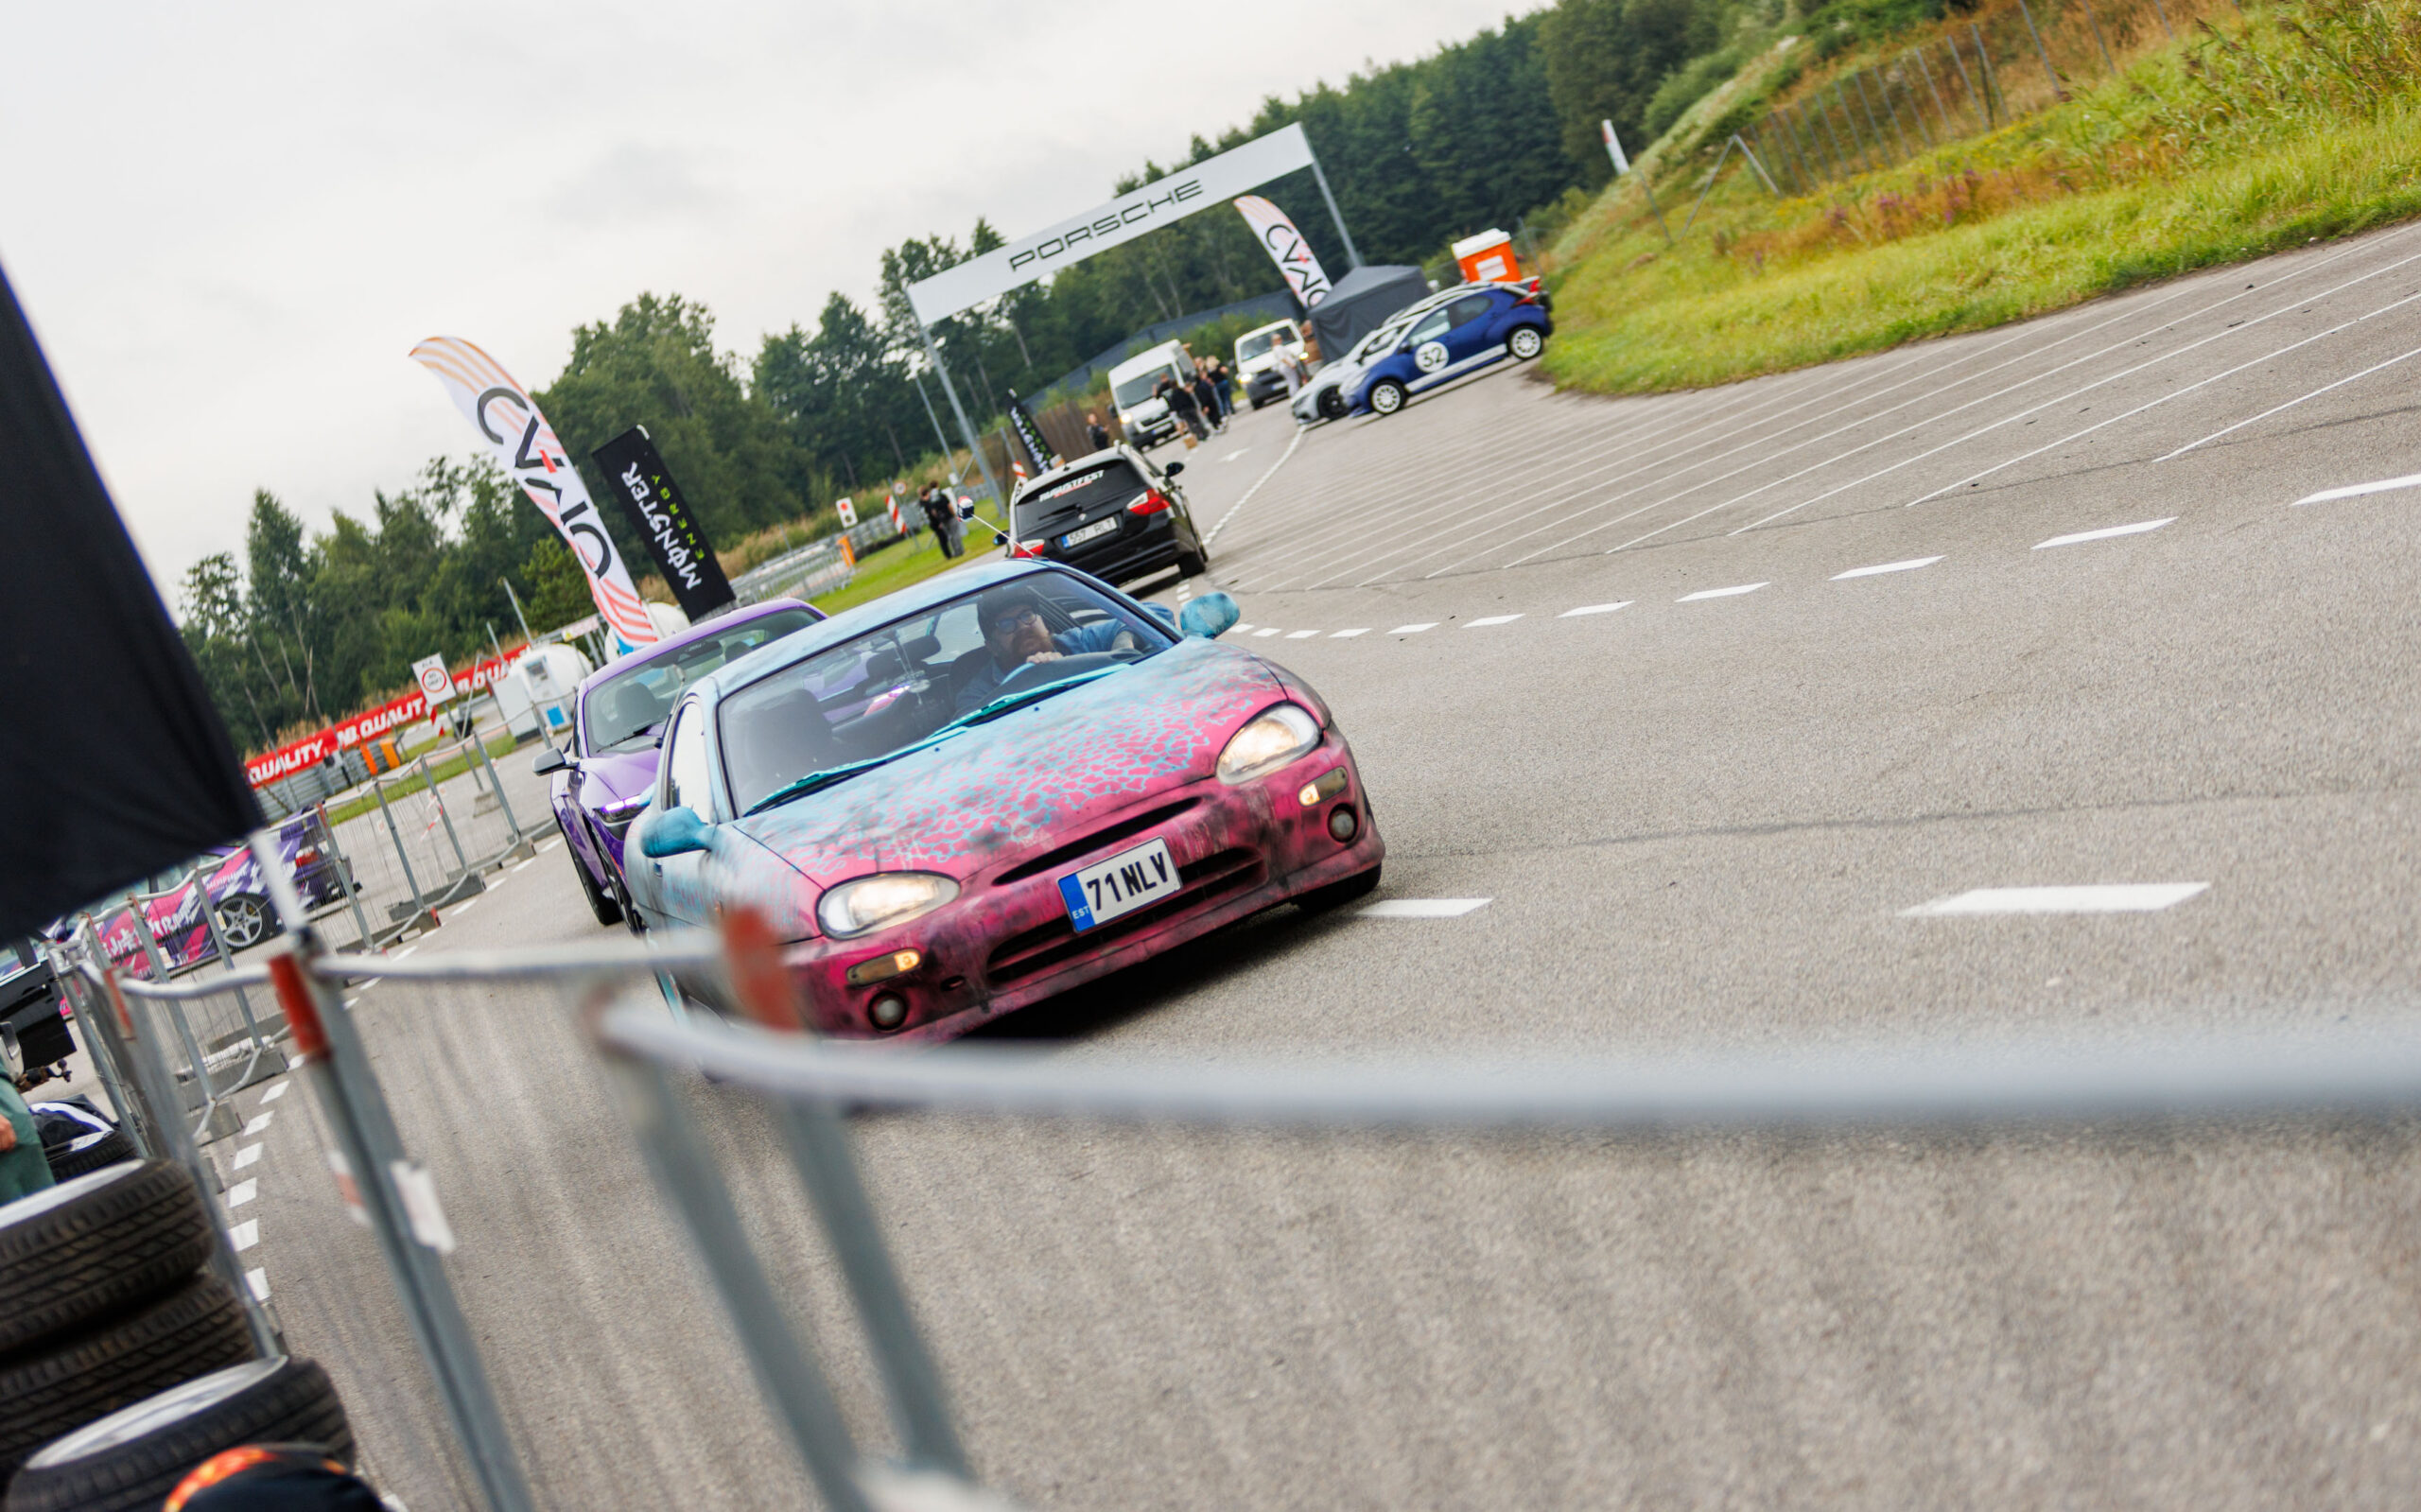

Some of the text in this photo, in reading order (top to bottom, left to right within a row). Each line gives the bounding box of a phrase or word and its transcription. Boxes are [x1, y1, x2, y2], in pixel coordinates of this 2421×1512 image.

[1008, 179, 1204, 272] PORSCHE
[1420, 346, 1446, 369] 32
[1069, 530, 1087, 545] 557
[1093, 518, 1114, 534] RLT
[359, 696, 425, 739] QUALIT
[1086, 851, 1169, 912] 71NLV
[1071, 905, 1090, 920] EST
